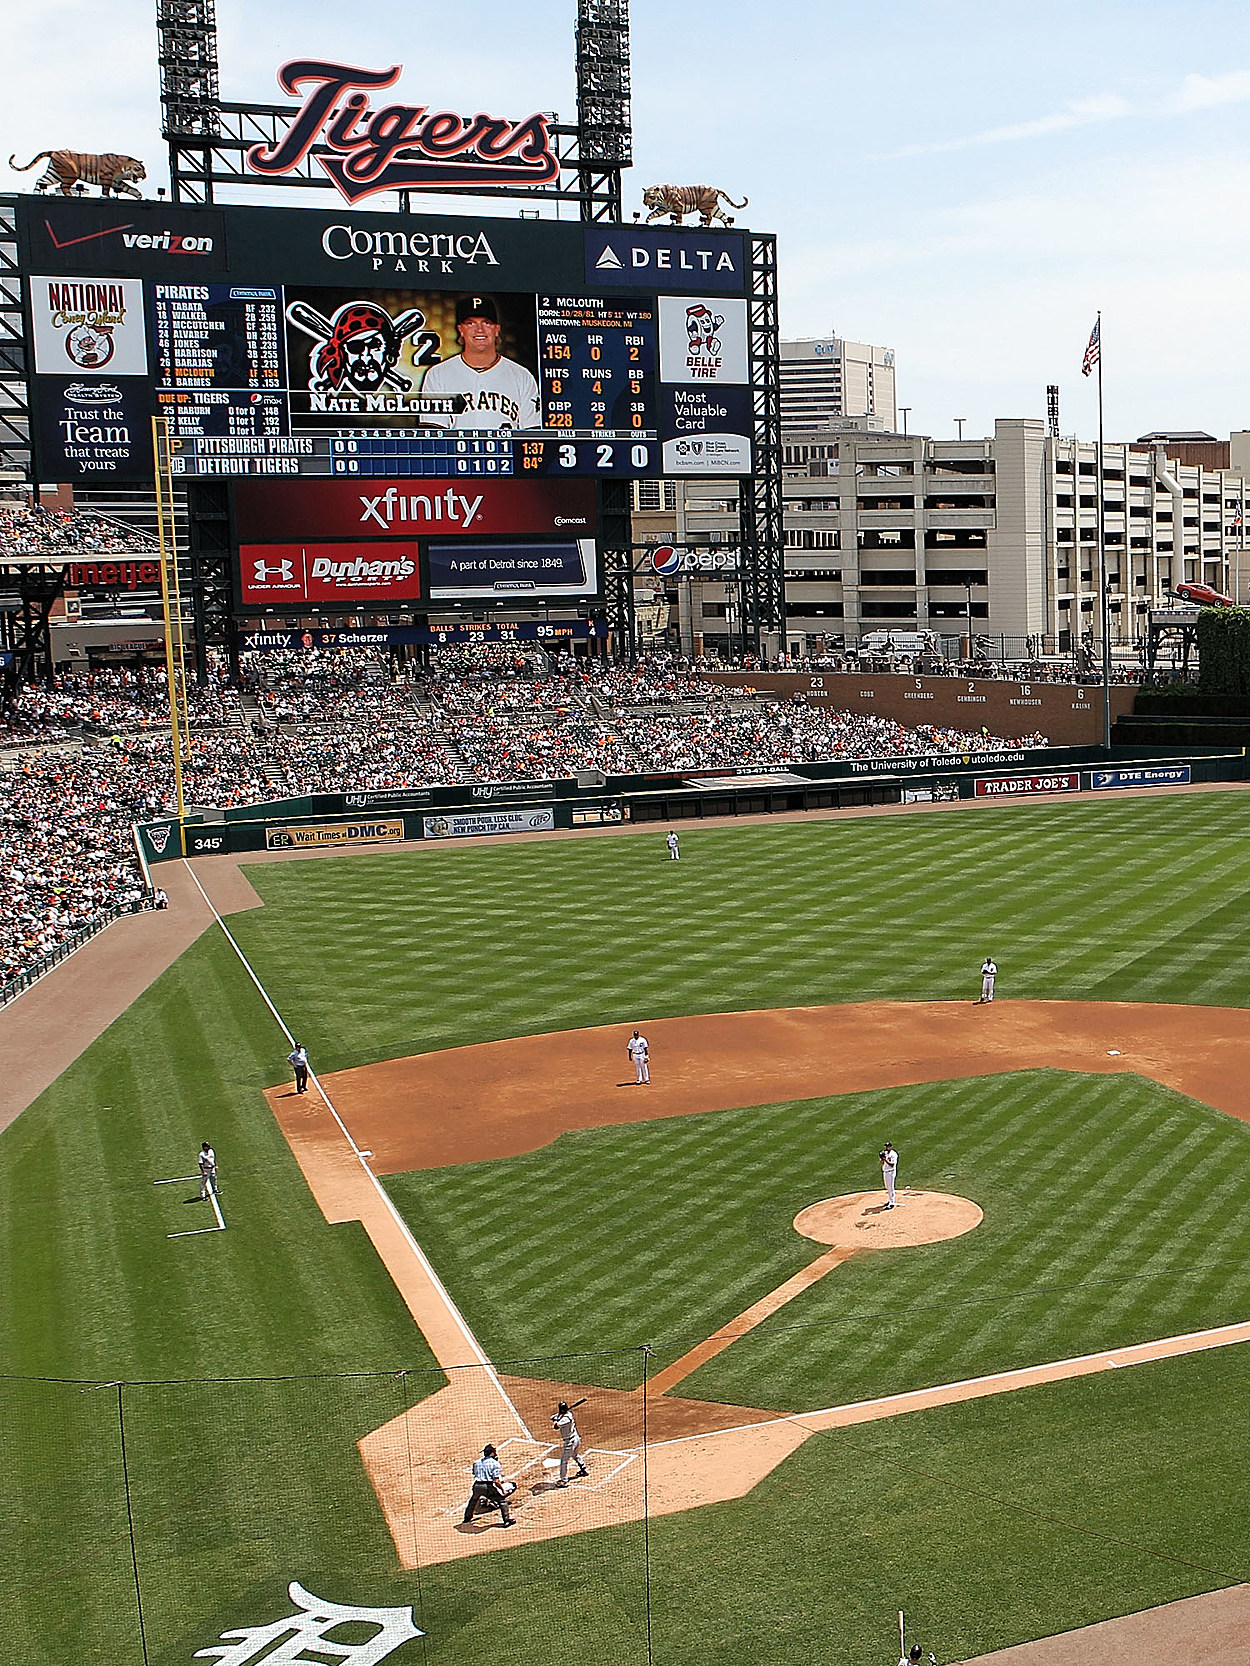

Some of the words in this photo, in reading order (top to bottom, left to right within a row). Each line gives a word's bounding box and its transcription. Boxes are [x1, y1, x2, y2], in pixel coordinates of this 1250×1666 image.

[246, 57, 560, 203] Tigers
[122, 230, 214, 255] verizon
[631, 246, 735, 272] DELTA
[372, 257, 454, 274] PARK
[155, 284, 210, 301] PIRATES
[172, 302, 203, 311] TABATA
[542, 298, 550, 306] 2
[556, 298, 604, 308] MCLOUTH
[172, 311, 207, 320] WALKER
[173, 321, 225, 330] MCCUTCHEN
[174, 330, 209, 339] ALVAREZ
[545, 334, 567, 343] AVG
[587, 335, 603, 344] HR
[625, 336, 644, 345] RBI
[174, 340, 200, 348] JONES
[174, 349, 218, 358] HARRISON
[542, 345, 571, 360] .154
[175, 358, 213, 368] BARAJAS
[686, 356, 722, 368] BELLE
[175, 368, 215, 377] MCLOUTH
[545, 368, 570, 378] HITS
[582, 369, 612, 379] RUNS
[628, 370, 644, 379] BB
[691, 367, 717, 378] TIRE
[176, 378, 211, 387] BARMES
[158, 394, 175, 403] DUE
[193, 393, 230, 404] TIGERS
[674, 391, 707, 403] Most
[548, 402, 571, 411] OBP
[590, 402, 606, 411] 2B
[630, 402, 645, 412] 3B
[674, 404, 728, 416] Valuable
[64, 407, 99, 420] Trust
[103, 408, 124, 420] the
[178, 417, 200, 425] KELLY
[545, 414, 572, 427] .228
[675, 417, 705, 429] Card
[59, 420, 132, 443] Team
[179, 427, 204, 435] DIRKS
[64, 446, 90, 458] that
[94, 447, 130, 458] treats
[197, 438, 265, 454] PITTSBURGH
[269, 438, 313, 454] PIRATES
[522, 442, 544, 454] 1:37
[559, 445, 577, 468] 3
[596, 445, 613, 468] 2
[631, 445, 648, 468] 0
[79, 461, 117, 473] yours
[198, 458, 250, 474] DETROIT
[254, 458, 299, 474] TIGERS
[359, 487, 482, 529] xfinity
[450, 561, 457, 570] A
[460, 560, 477, 571] part
[479, 559, 487, 569] of
[490, 559, 515, 569] Detroit
[517, 558, 539, 568] since
[541, 558, 564, 568] 1849.
[684, 548, 740, 571] pepsi
[311, 555, 415, 578] Dunham's
[469, 631, 485, 642] 23
[500, 630, 516, 640] 31
[537, 626, 554, 637] 95
[244, 633, 290, 648] xfinity
[322, 635, 336, 644] 37
[339, 633, 388, 643] Scherzer
[810, 677, 824, 688] 23
[915, 679, 922, 689] 5
[968, 682, 975, 693] 2
[1021, 685, 1031, 696] 16
[1078, 689, 1084, 700] 6
[850, 762, 868, 772] The
[870, 760, 917, 770] University
[920, 758, 929, 767] of
[931, 757, 962, 767] Toledo
[972, 753, 1025, 764] utoledo.edu
[1120, 772, 1142, 781] DTE
[1144, 770, 1182, 780] Energy
[984, 780, 1033, 794] TRADER
[1035, 777, 1069, 791] JOE'S
[452, 816, 477, 825] SMOOTH
[494, 815, 507, 823] LESS
[453, 825, 466, 834] NEW
[466, 824, 486, 833] PUNCH
[272, 835, 289, 846] ER
[296, 831, 315, 842] Wait
[316, 830, 340, 841] Times
